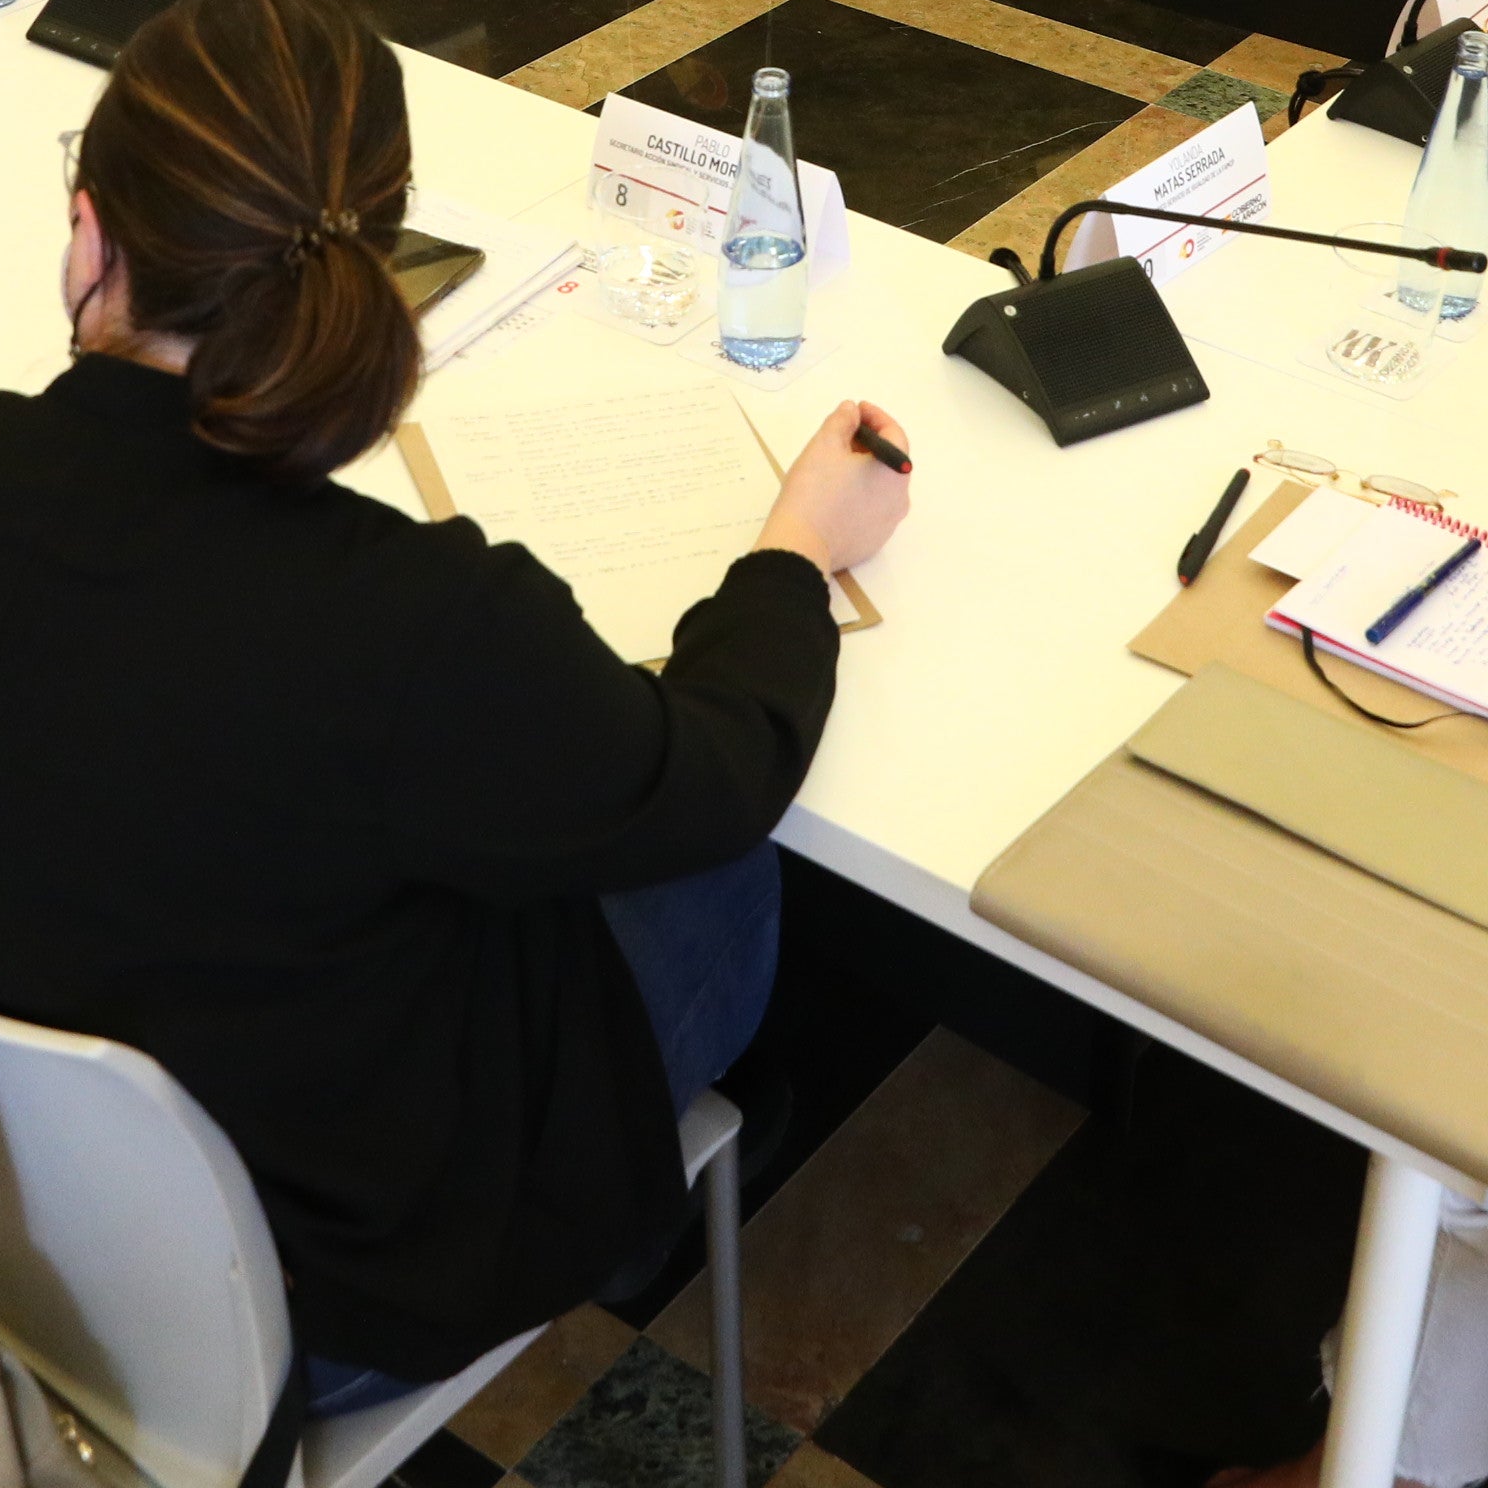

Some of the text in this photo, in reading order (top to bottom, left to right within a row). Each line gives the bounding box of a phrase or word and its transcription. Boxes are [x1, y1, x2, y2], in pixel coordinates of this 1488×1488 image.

[647, 134, 707, 168] CASTILLO
[695, 134, 731, 158] PABLO
[1168, 144, 1204, 171] YOLANDA
[1154, 147, 1226, 201] MATAS SERRADA
[616, 184, 628, 207] 8
